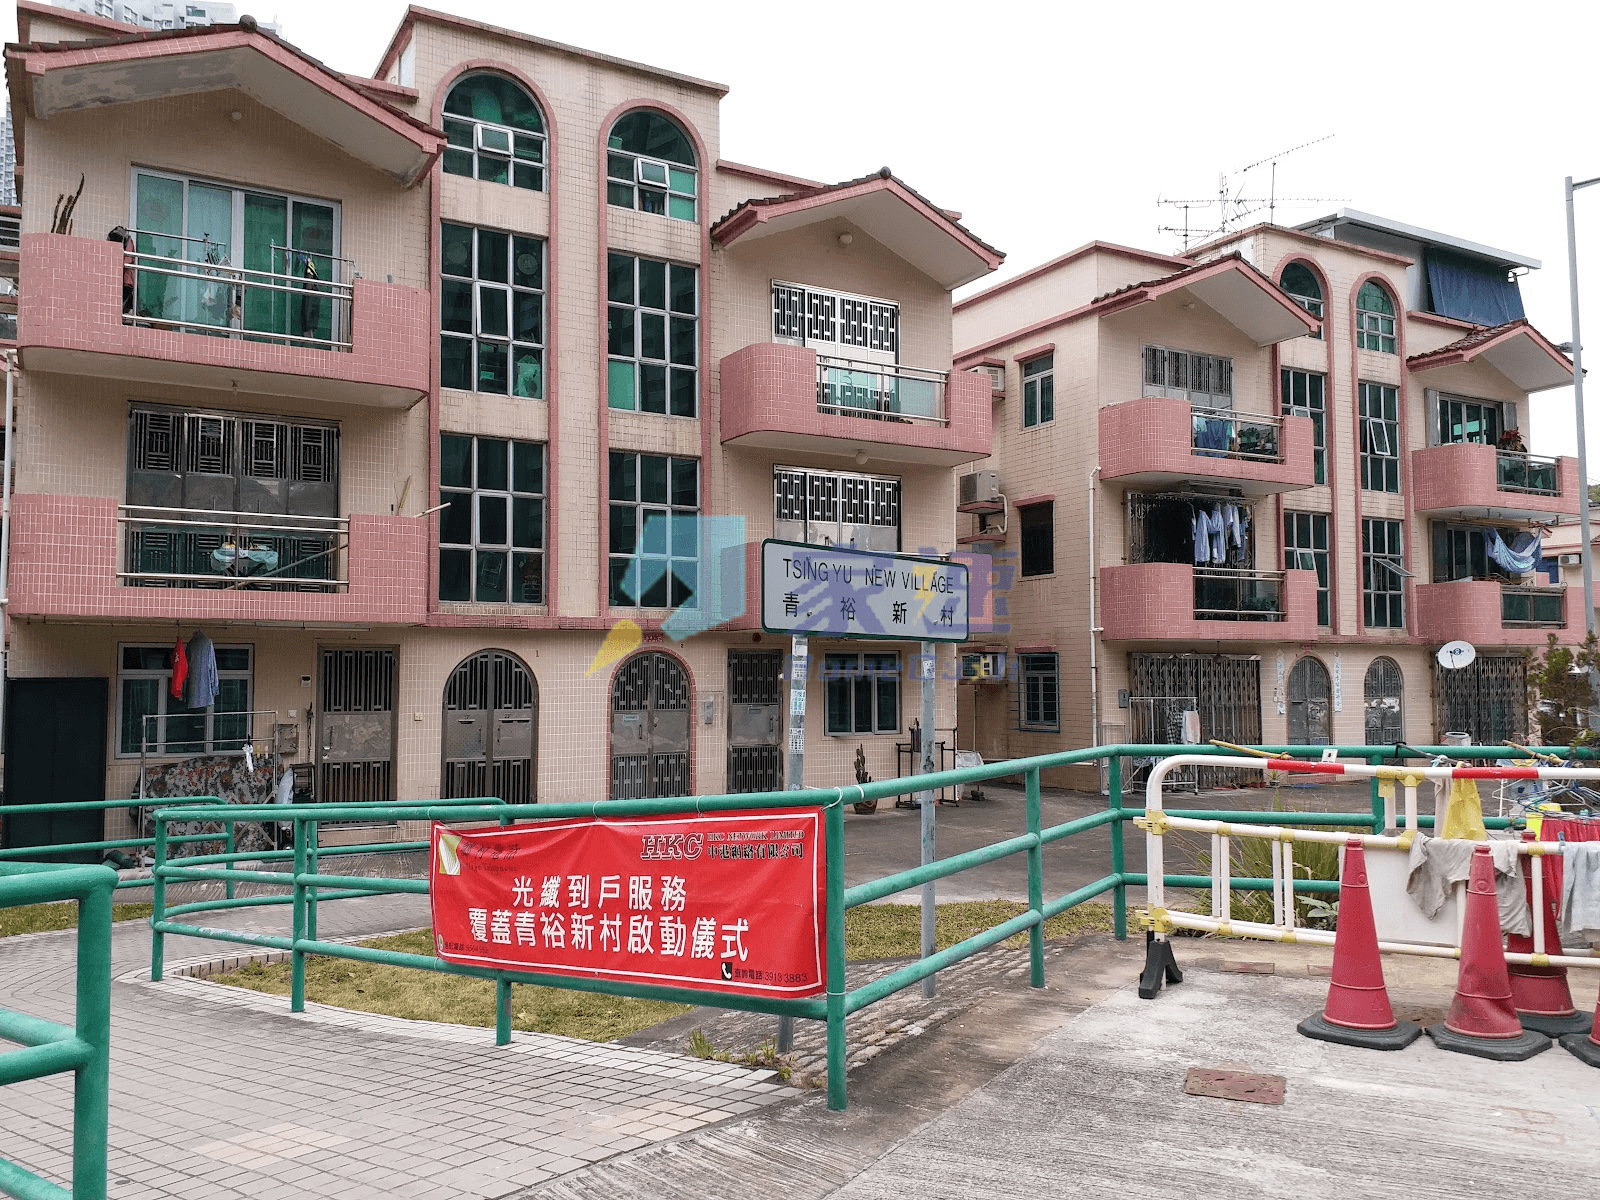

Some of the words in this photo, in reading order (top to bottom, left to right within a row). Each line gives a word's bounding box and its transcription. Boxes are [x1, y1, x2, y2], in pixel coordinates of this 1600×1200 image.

[783, 558, 829, 582] TSING
[832, 564, 852, 584] YU
[865, 568, 897, 588] NEW
[902, 571, 954, 594] VILLAGE
[783, 592, 954, 627] 青裕新村
[640, 832, 704, 861] HKC
[728, 830, 769, 841] NETWORK
[770, 829, 805, 840] LIMITED
[707, 842, 804, 860] 中港網絡有限公司
